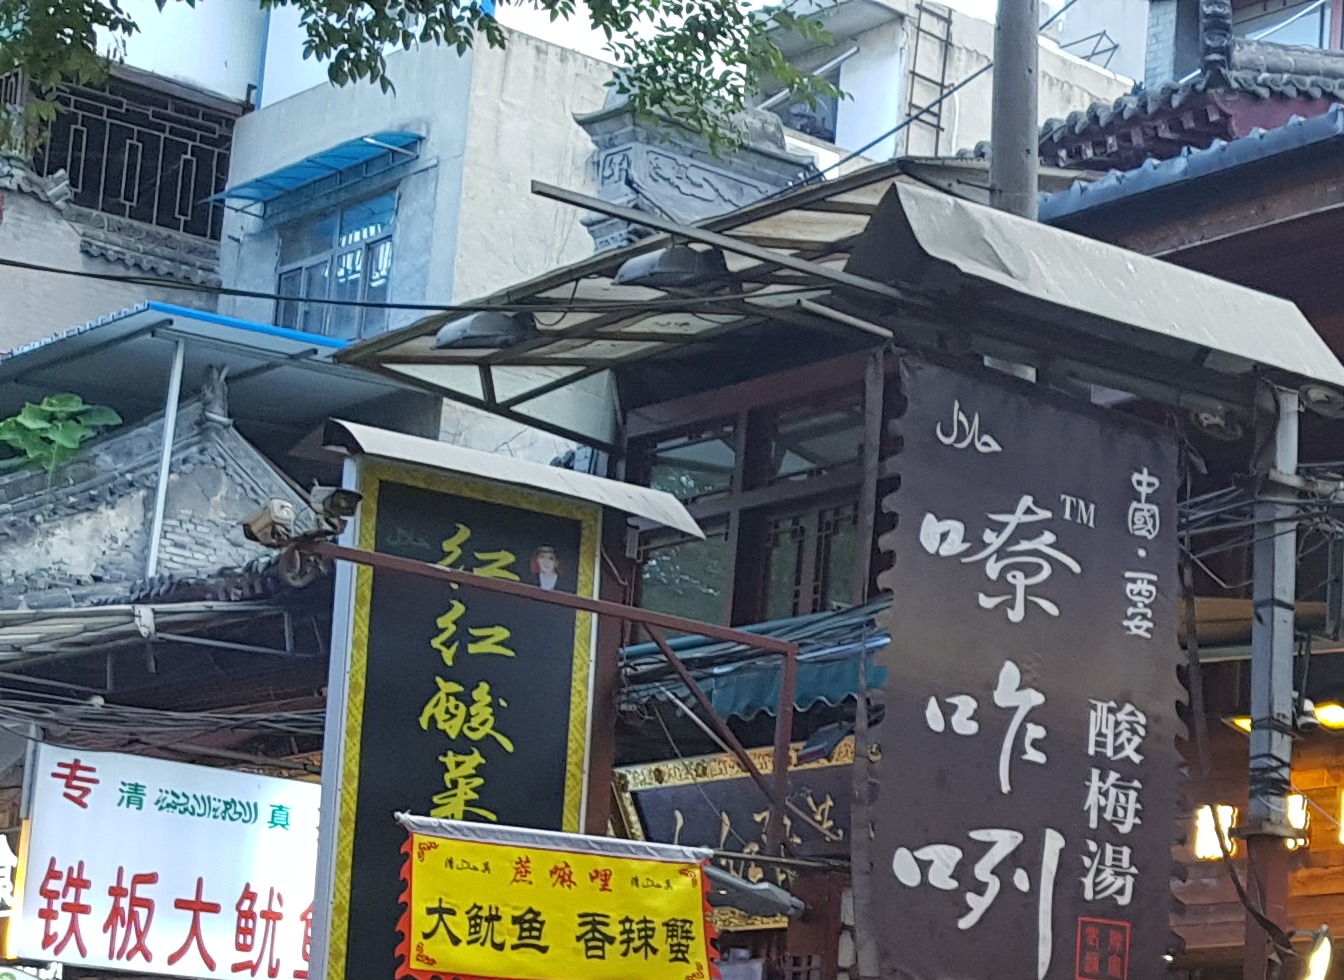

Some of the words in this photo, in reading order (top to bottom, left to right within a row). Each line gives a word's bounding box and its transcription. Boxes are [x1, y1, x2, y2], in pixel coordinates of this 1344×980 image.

[1060, 493, 1097, 530] TM
[50, 758, 101, 809] 专
[116, 780, 148, 812] 清
[1079, 698, 1148, 907] 酸梅湯
[421, 897, 551, 955] 大鱿鱼
[574, 911, 696, 964] 香辣蟹
